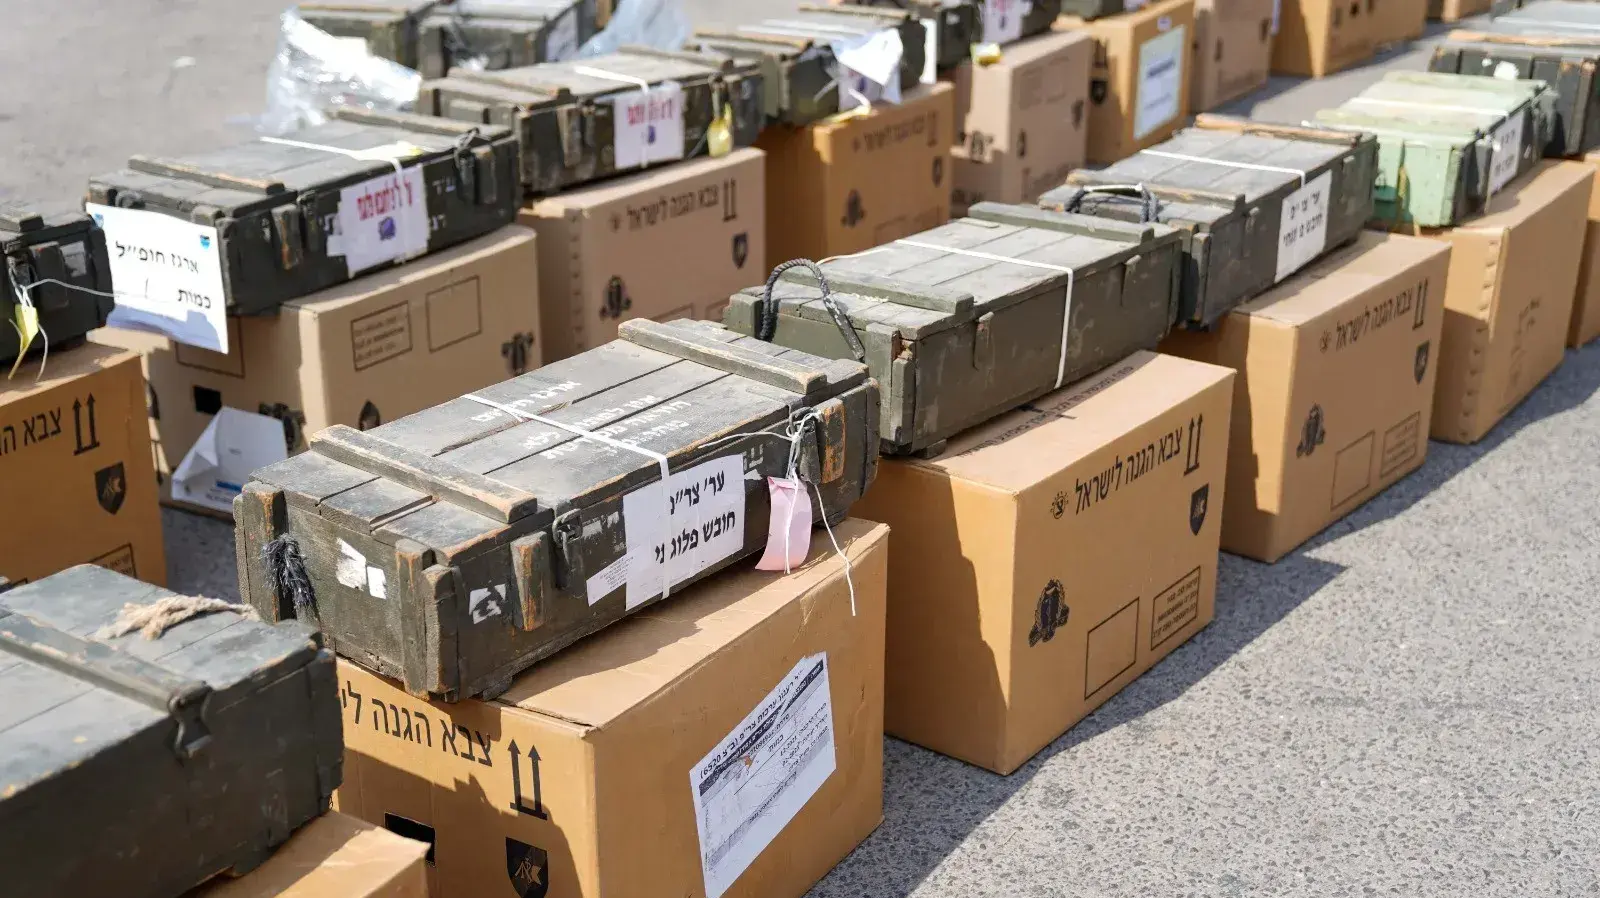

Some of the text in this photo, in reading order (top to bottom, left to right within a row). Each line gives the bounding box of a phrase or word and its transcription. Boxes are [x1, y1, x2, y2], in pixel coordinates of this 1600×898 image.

[172, 253, 199, 275] ארגז
[178, 287, 212, 309] כמות
[23, 406, 62, 447] צבא
[1075, 426, 1183, 516] צבא הגנה לישראל
[702, 510, 735, 543] חובש
[371, 698, 432, 748] הגנה
[440, 719, 493, 768] צבא
